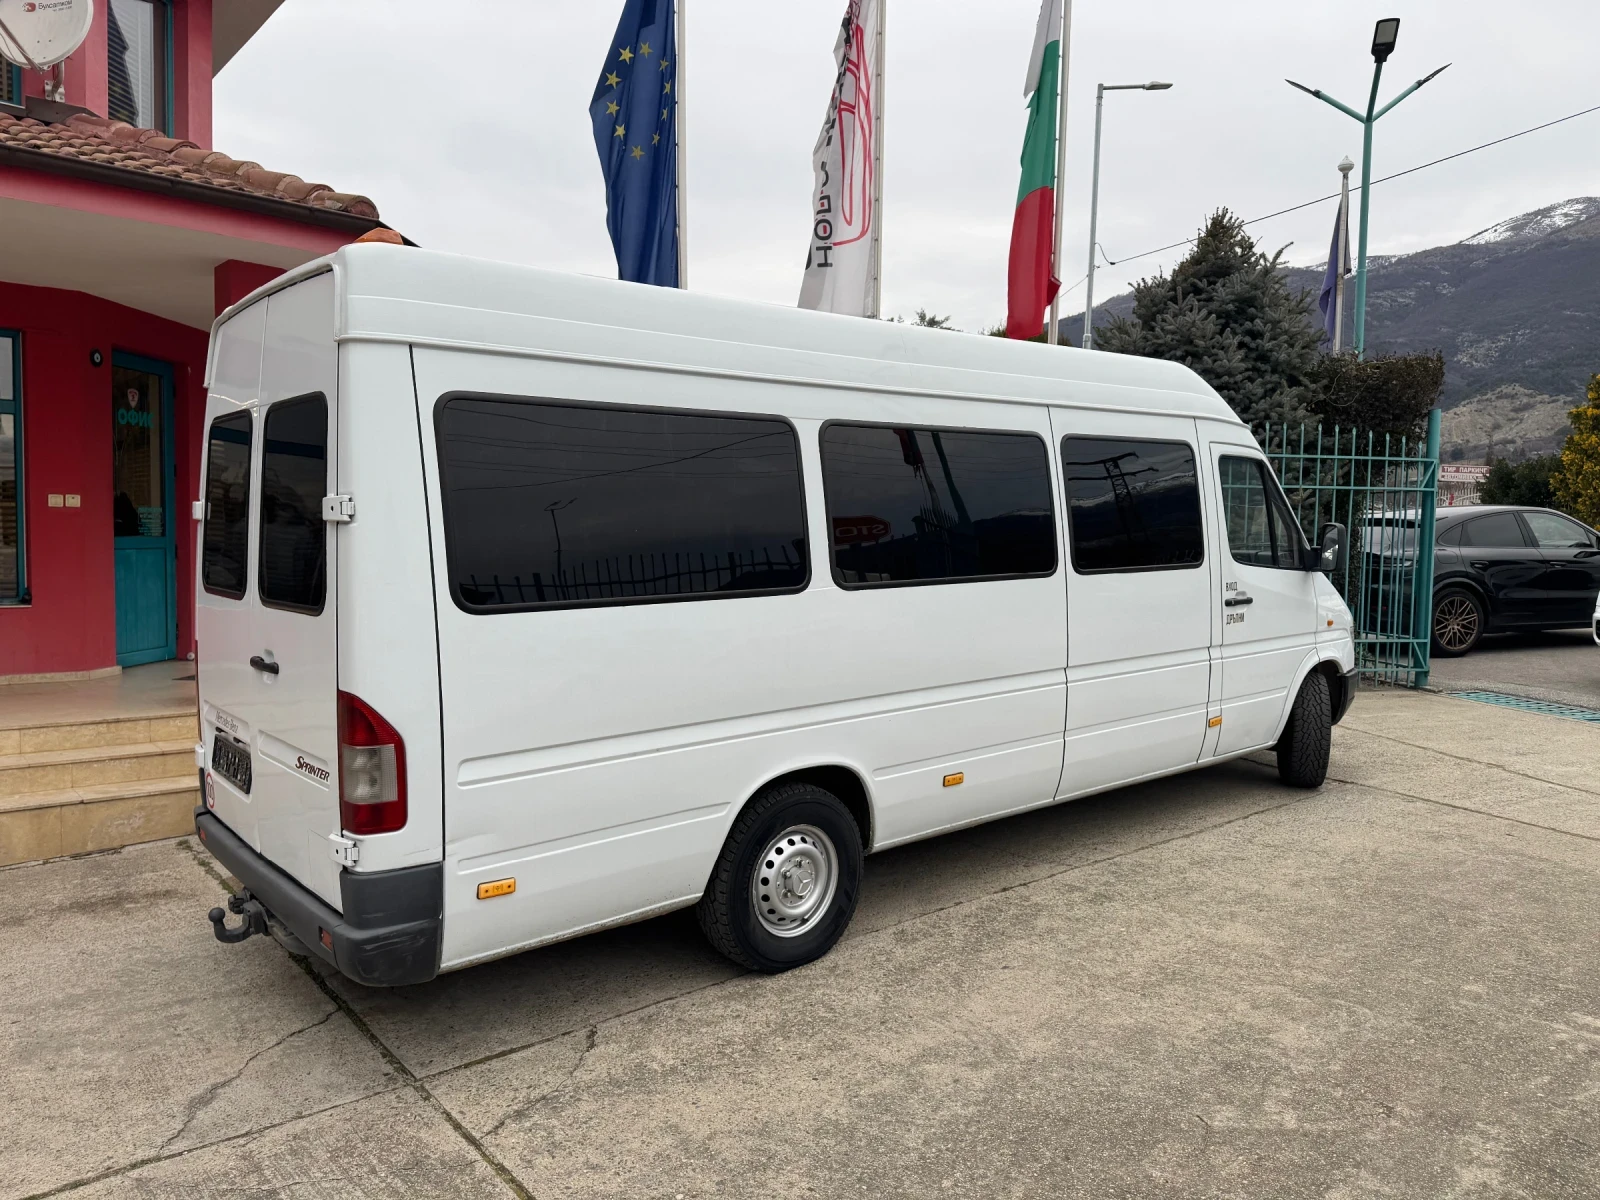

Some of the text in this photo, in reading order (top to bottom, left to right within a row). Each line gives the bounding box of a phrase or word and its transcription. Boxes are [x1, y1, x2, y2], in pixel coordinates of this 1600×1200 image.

[117, 407, 154, 429] ОФИС
[1226, 581, 1238, 591] ВХОД
[215, 711, 239, 734] Mercedes-Benz
